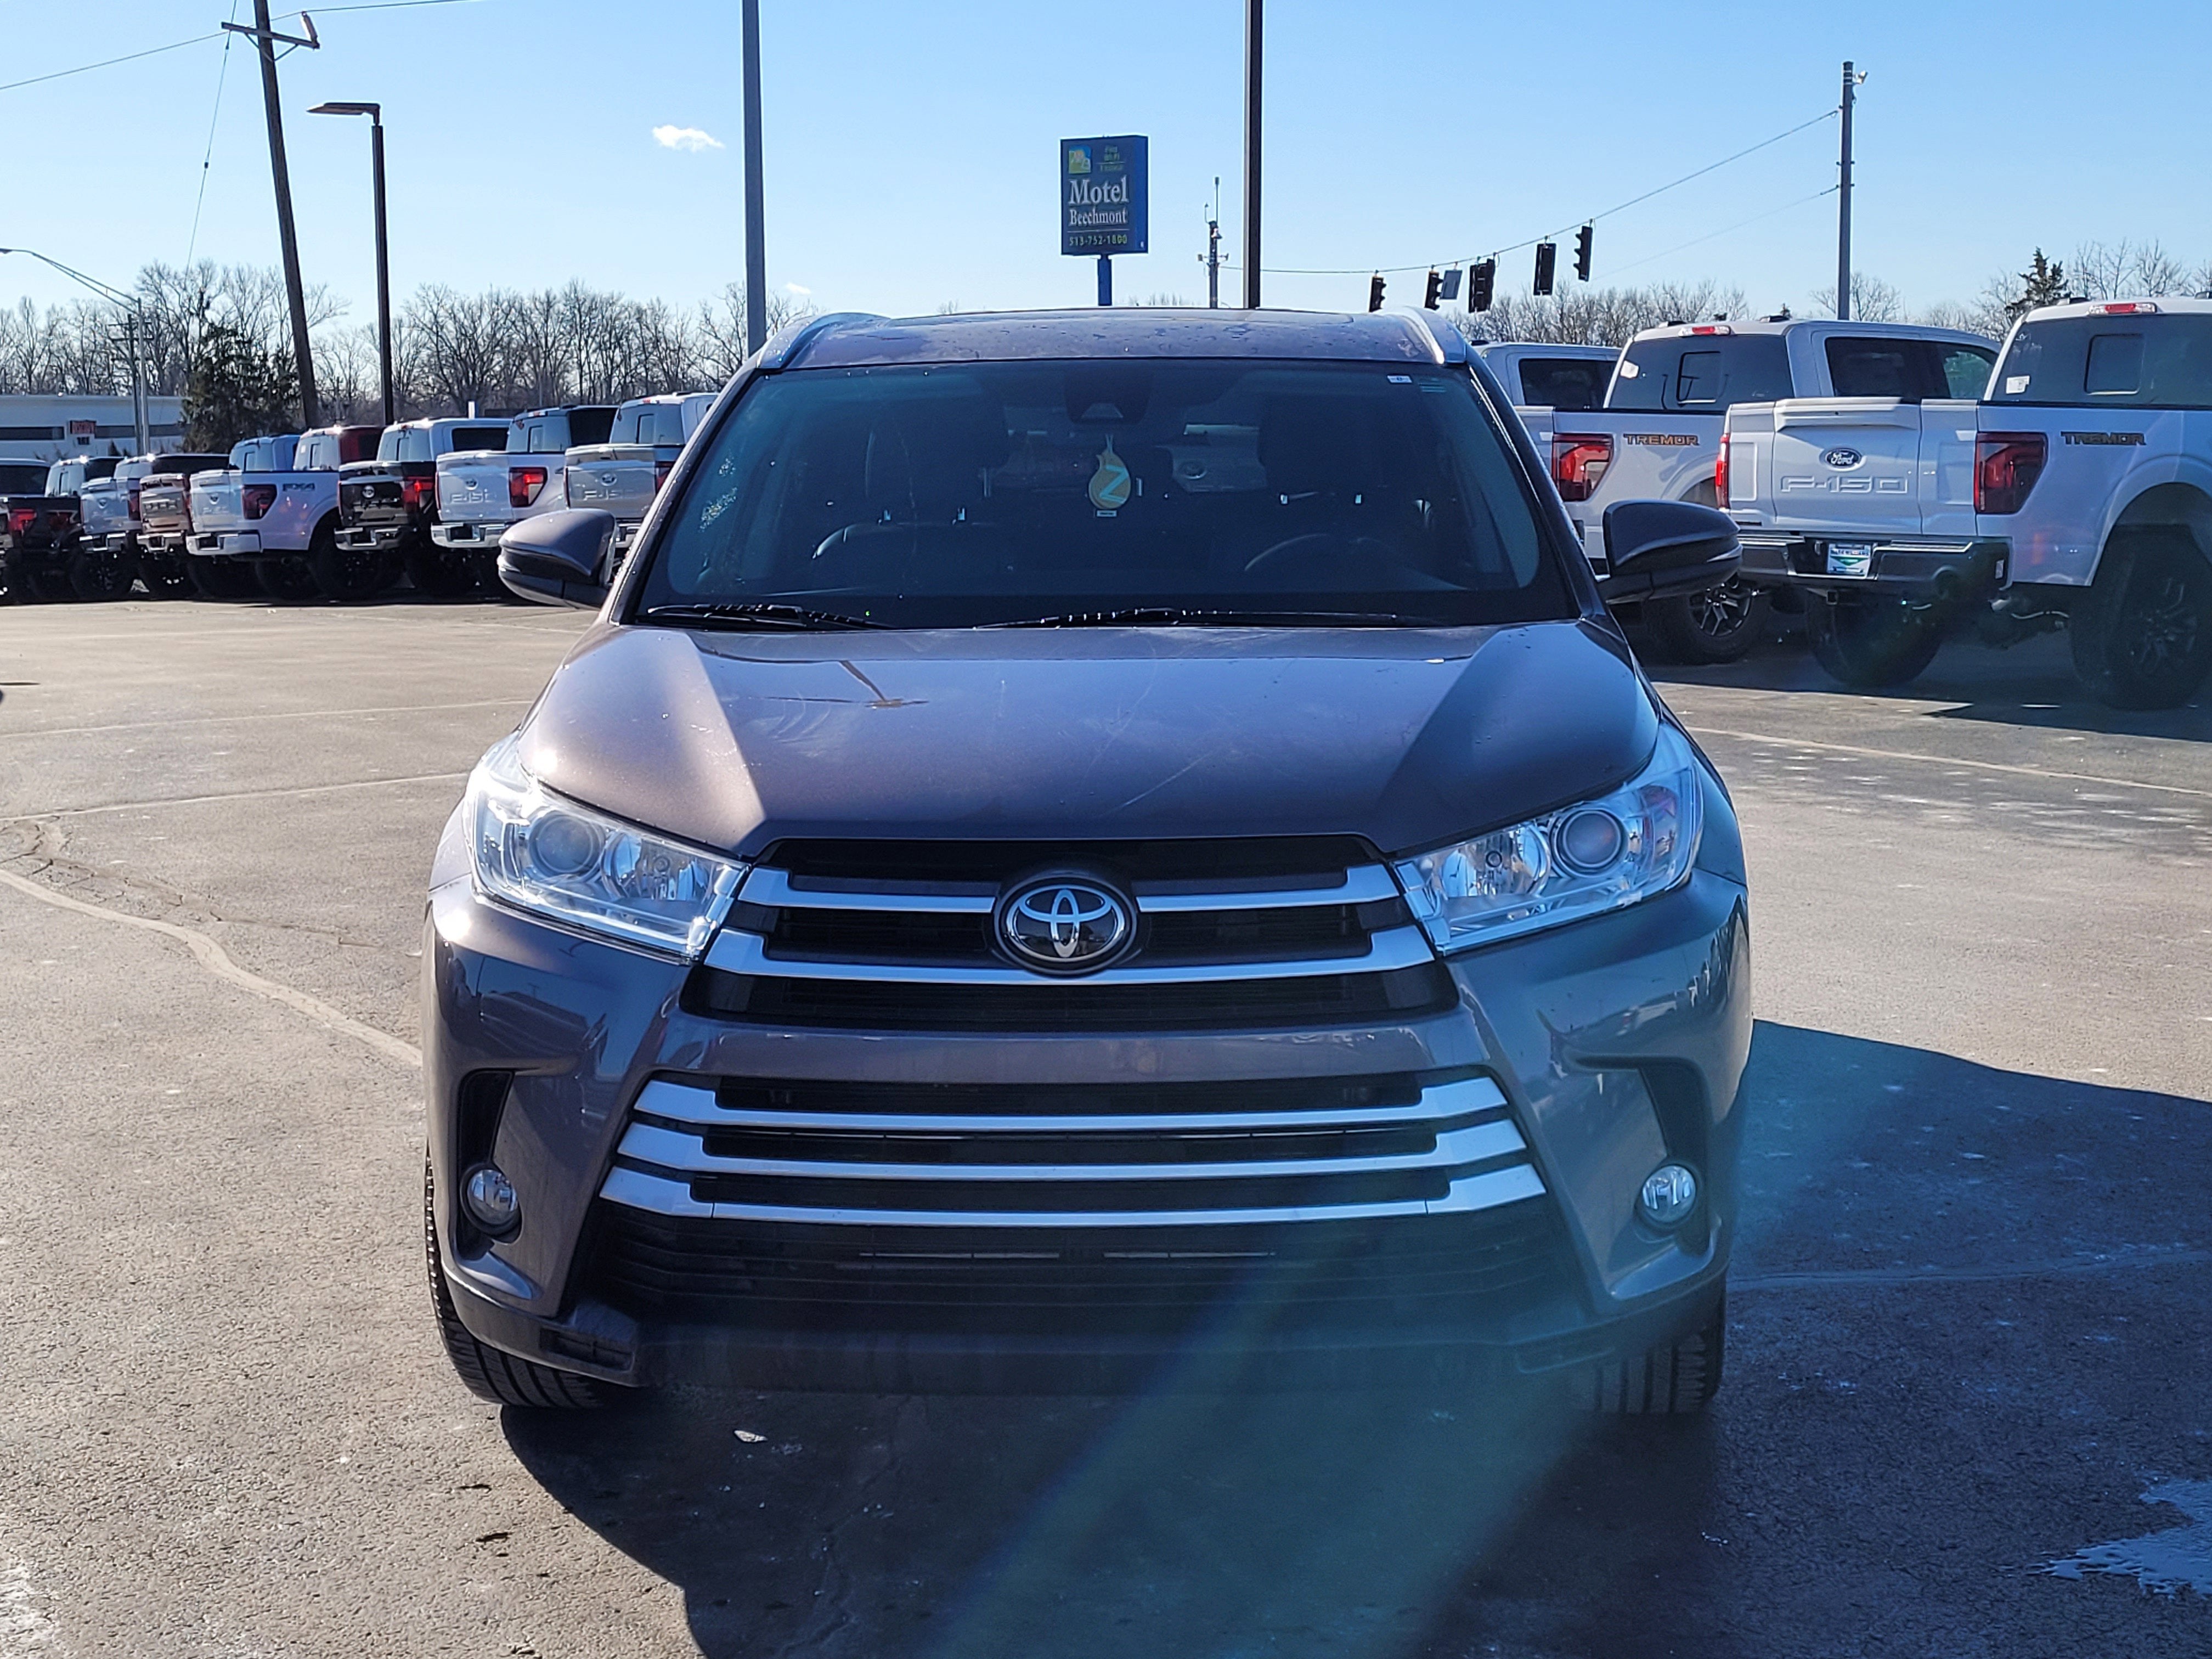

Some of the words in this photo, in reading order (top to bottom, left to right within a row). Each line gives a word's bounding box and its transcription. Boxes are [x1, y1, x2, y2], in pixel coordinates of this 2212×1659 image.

[1069, 175, 1129, 204] Motel
[1069, 207, 1128, 225] Beechmont
[1623, 433, 1700, 445] TREMOR
[2061, 431, 2147, 445] TREMOR
[1831, 452, 1854, 465] Ford
[1781, 476, 1908, 494] F-150
